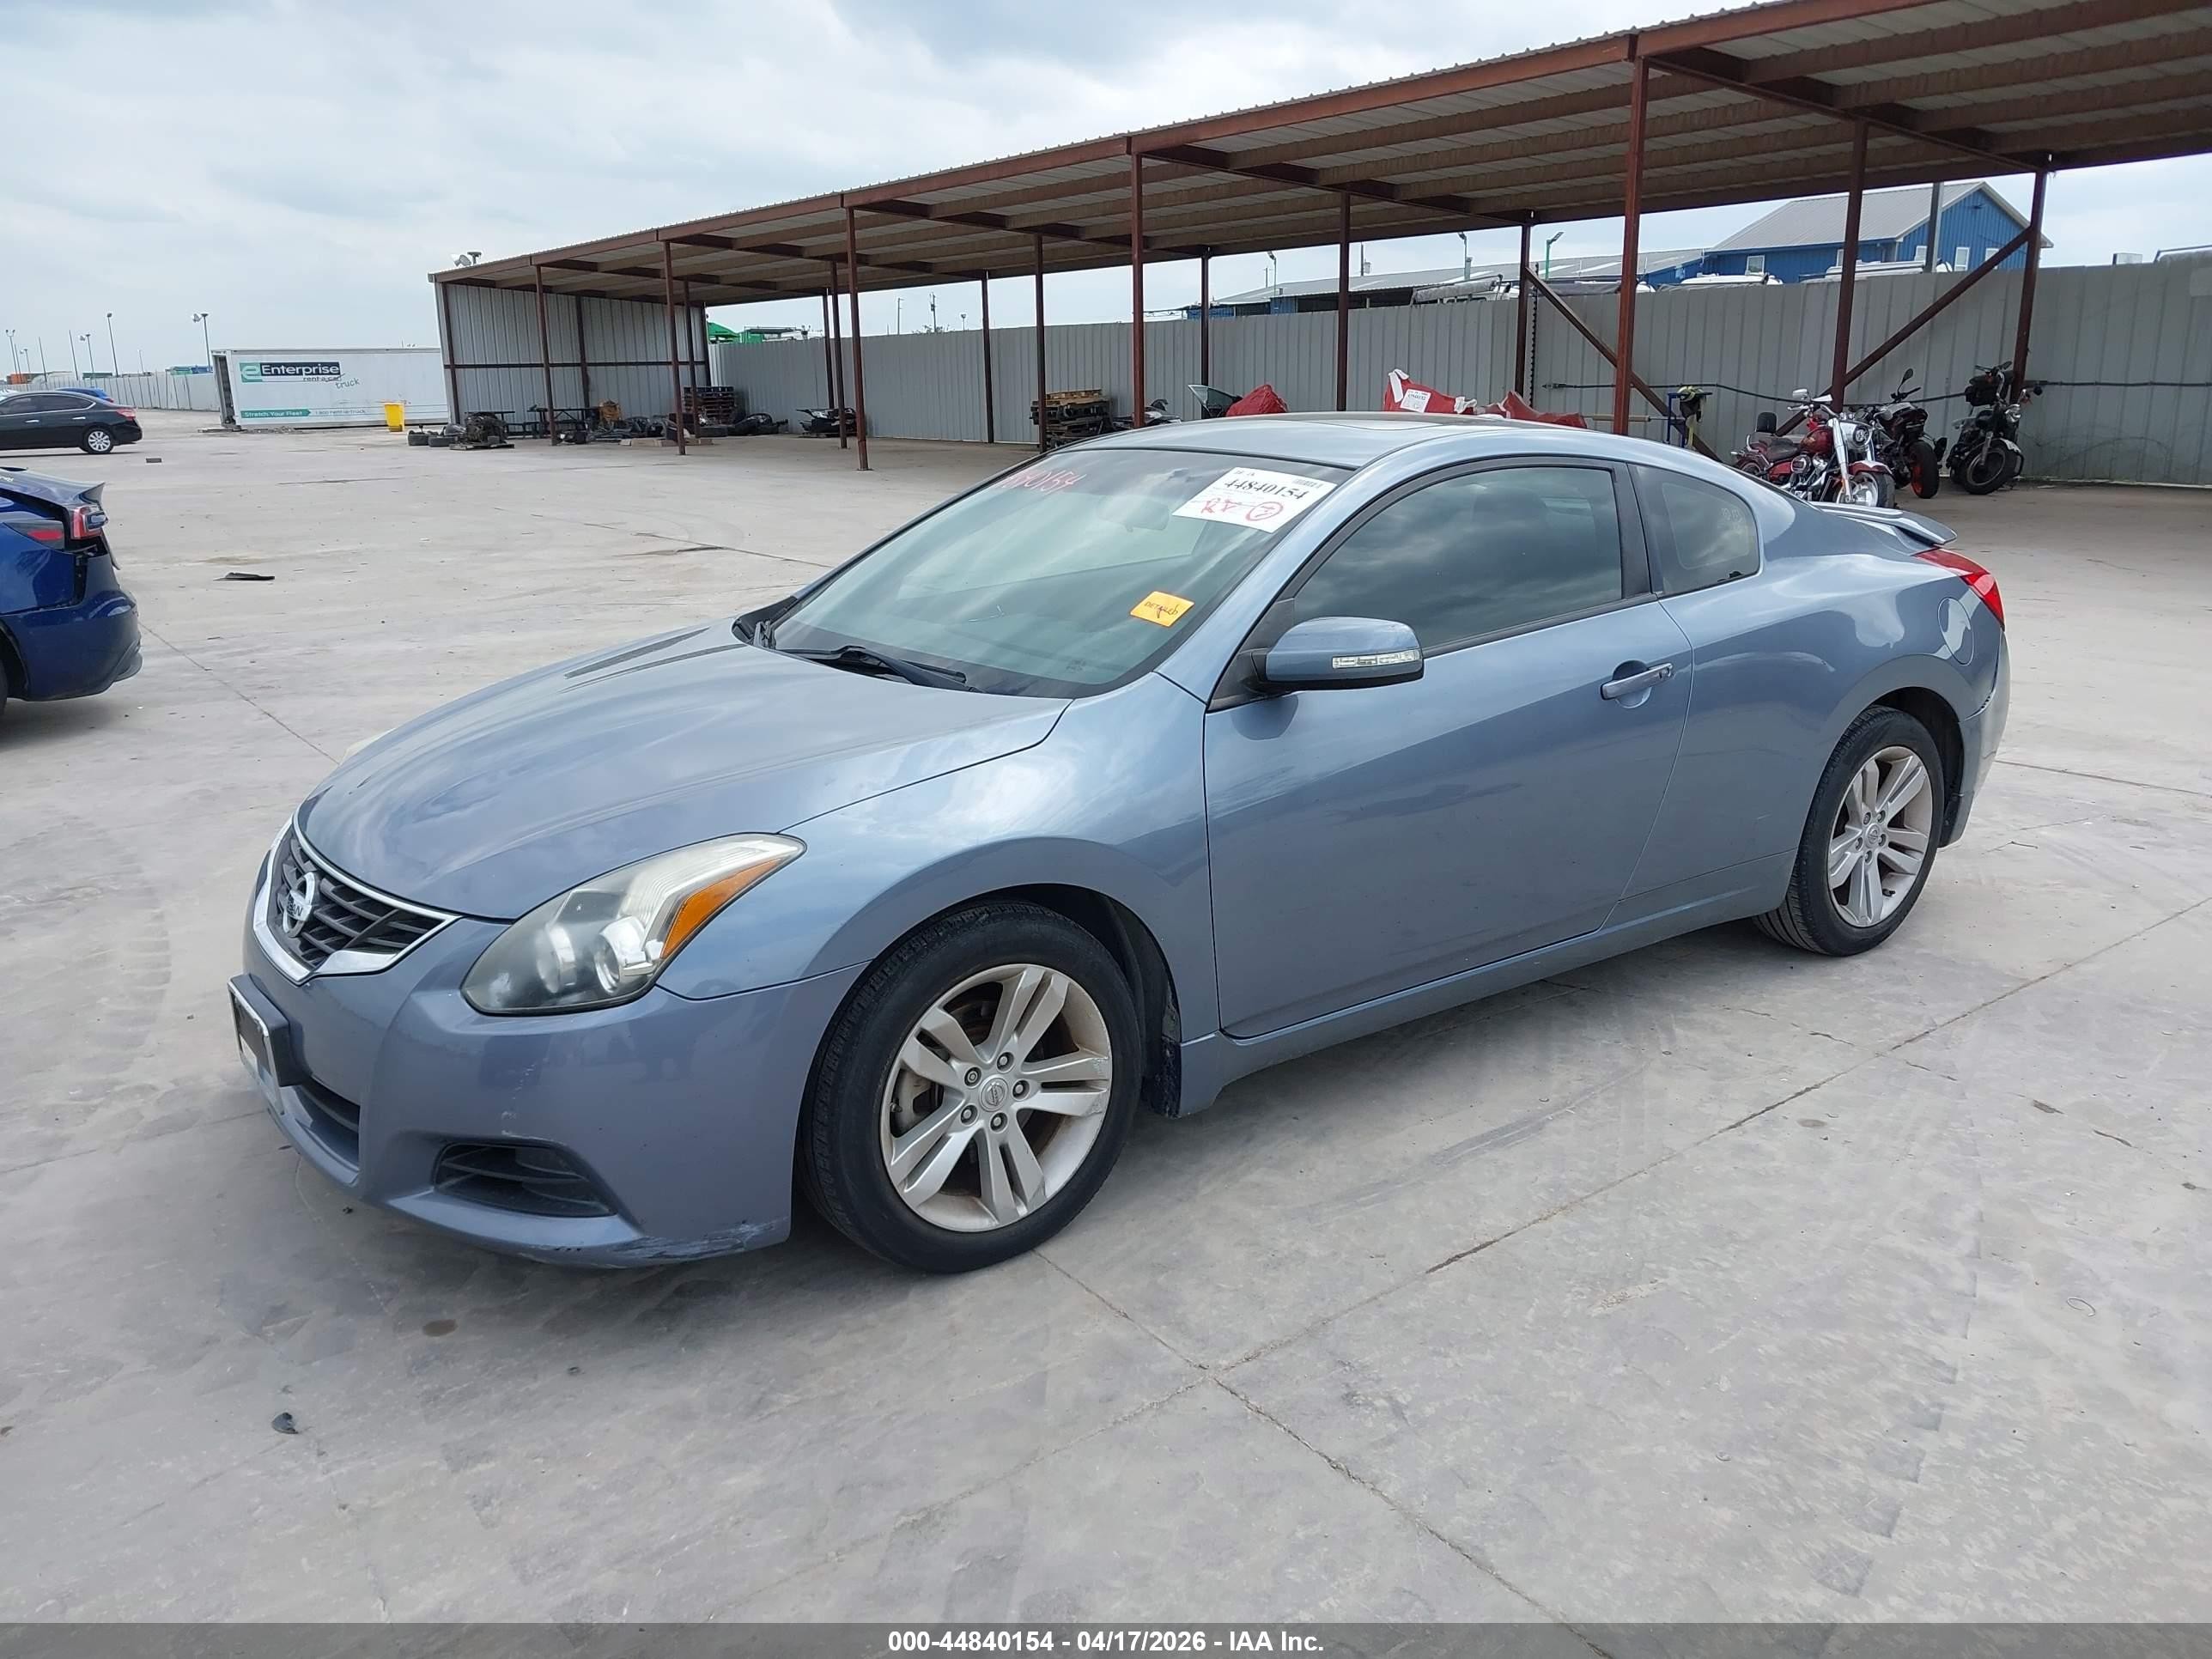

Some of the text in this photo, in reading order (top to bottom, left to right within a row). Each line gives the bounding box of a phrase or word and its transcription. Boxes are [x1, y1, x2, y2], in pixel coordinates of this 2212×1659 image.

[261, 363, 340, 377] Enterprise
[335, 377, 360, 389] truck
[1224, 478, 1310, 500] 44840154
